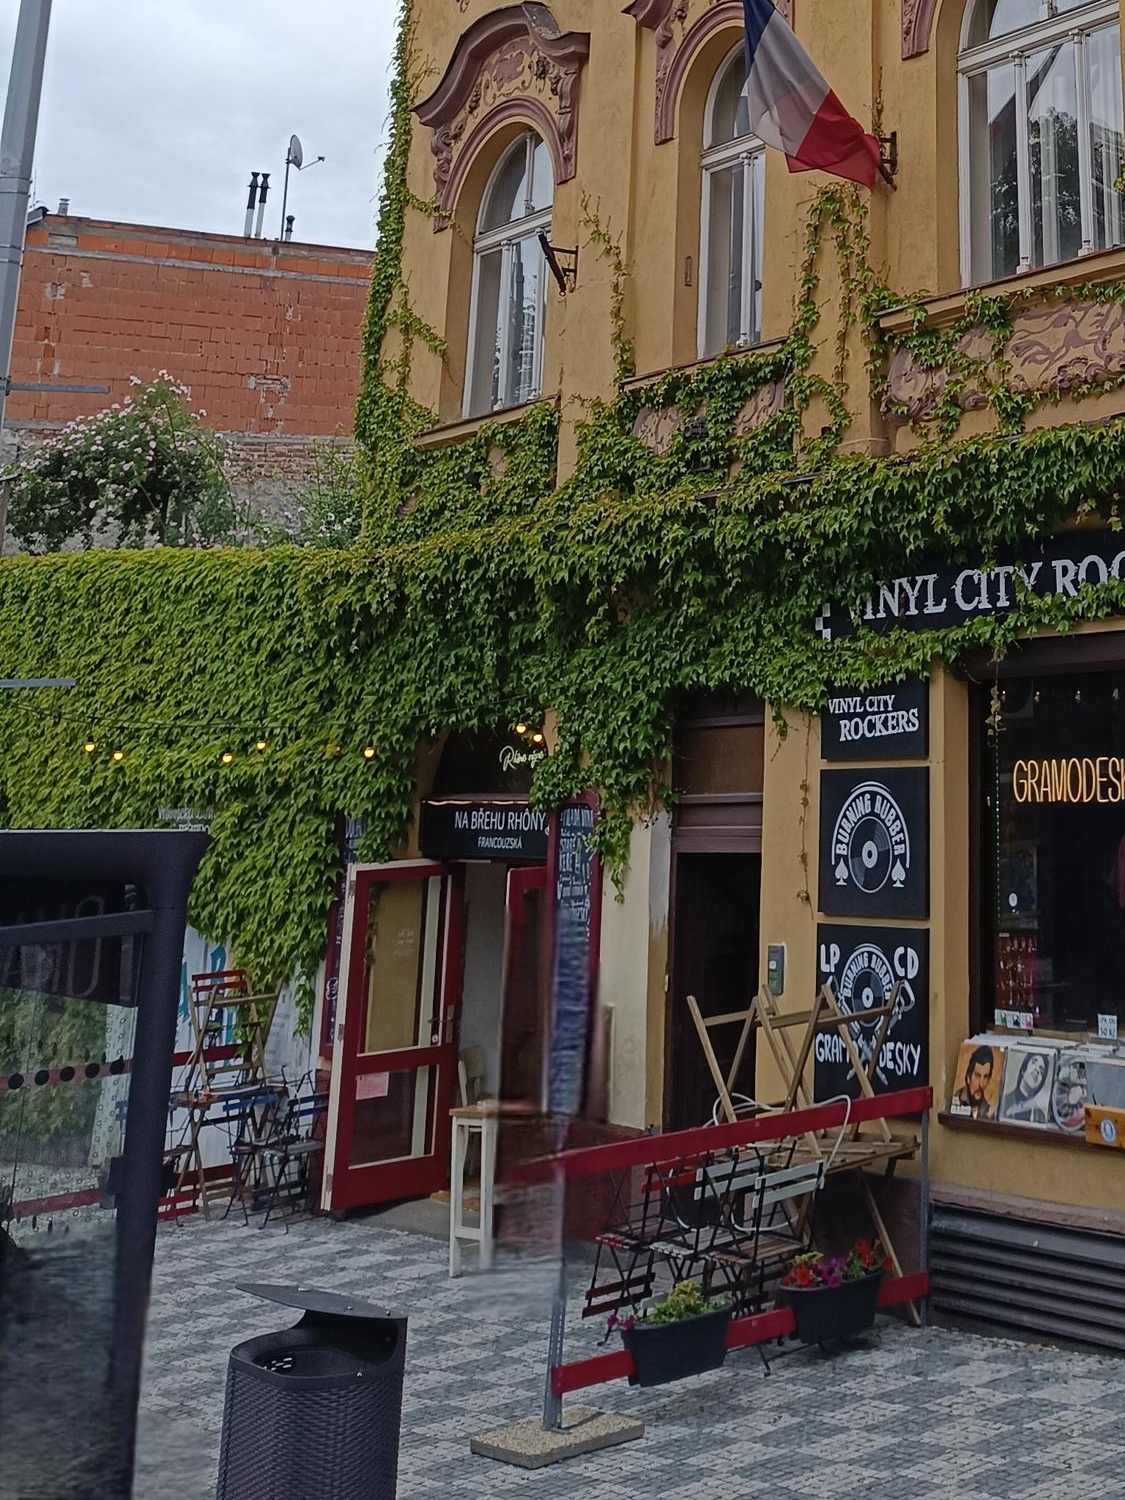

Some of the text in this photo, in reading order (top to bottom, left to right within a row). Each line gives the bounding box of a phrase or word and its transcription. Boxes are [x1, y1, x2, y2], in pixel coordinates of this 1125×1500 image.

[848, 573, 947, 620] INYL
[828, 694, 896, 714] VINYL CITY
[839, 708, 919, 741] ROCKERS
[454, 811, 469, 829] NA
[470, 808, 505, 830] BŘEHU
[507, 808, 546, 831] RHÔNY
[835, 793, 905, 856] BURNING RUBBER
[477, 836, 522, 850] FRANCOUZSKÁ
[820, 943, 919, 979] LP CD
